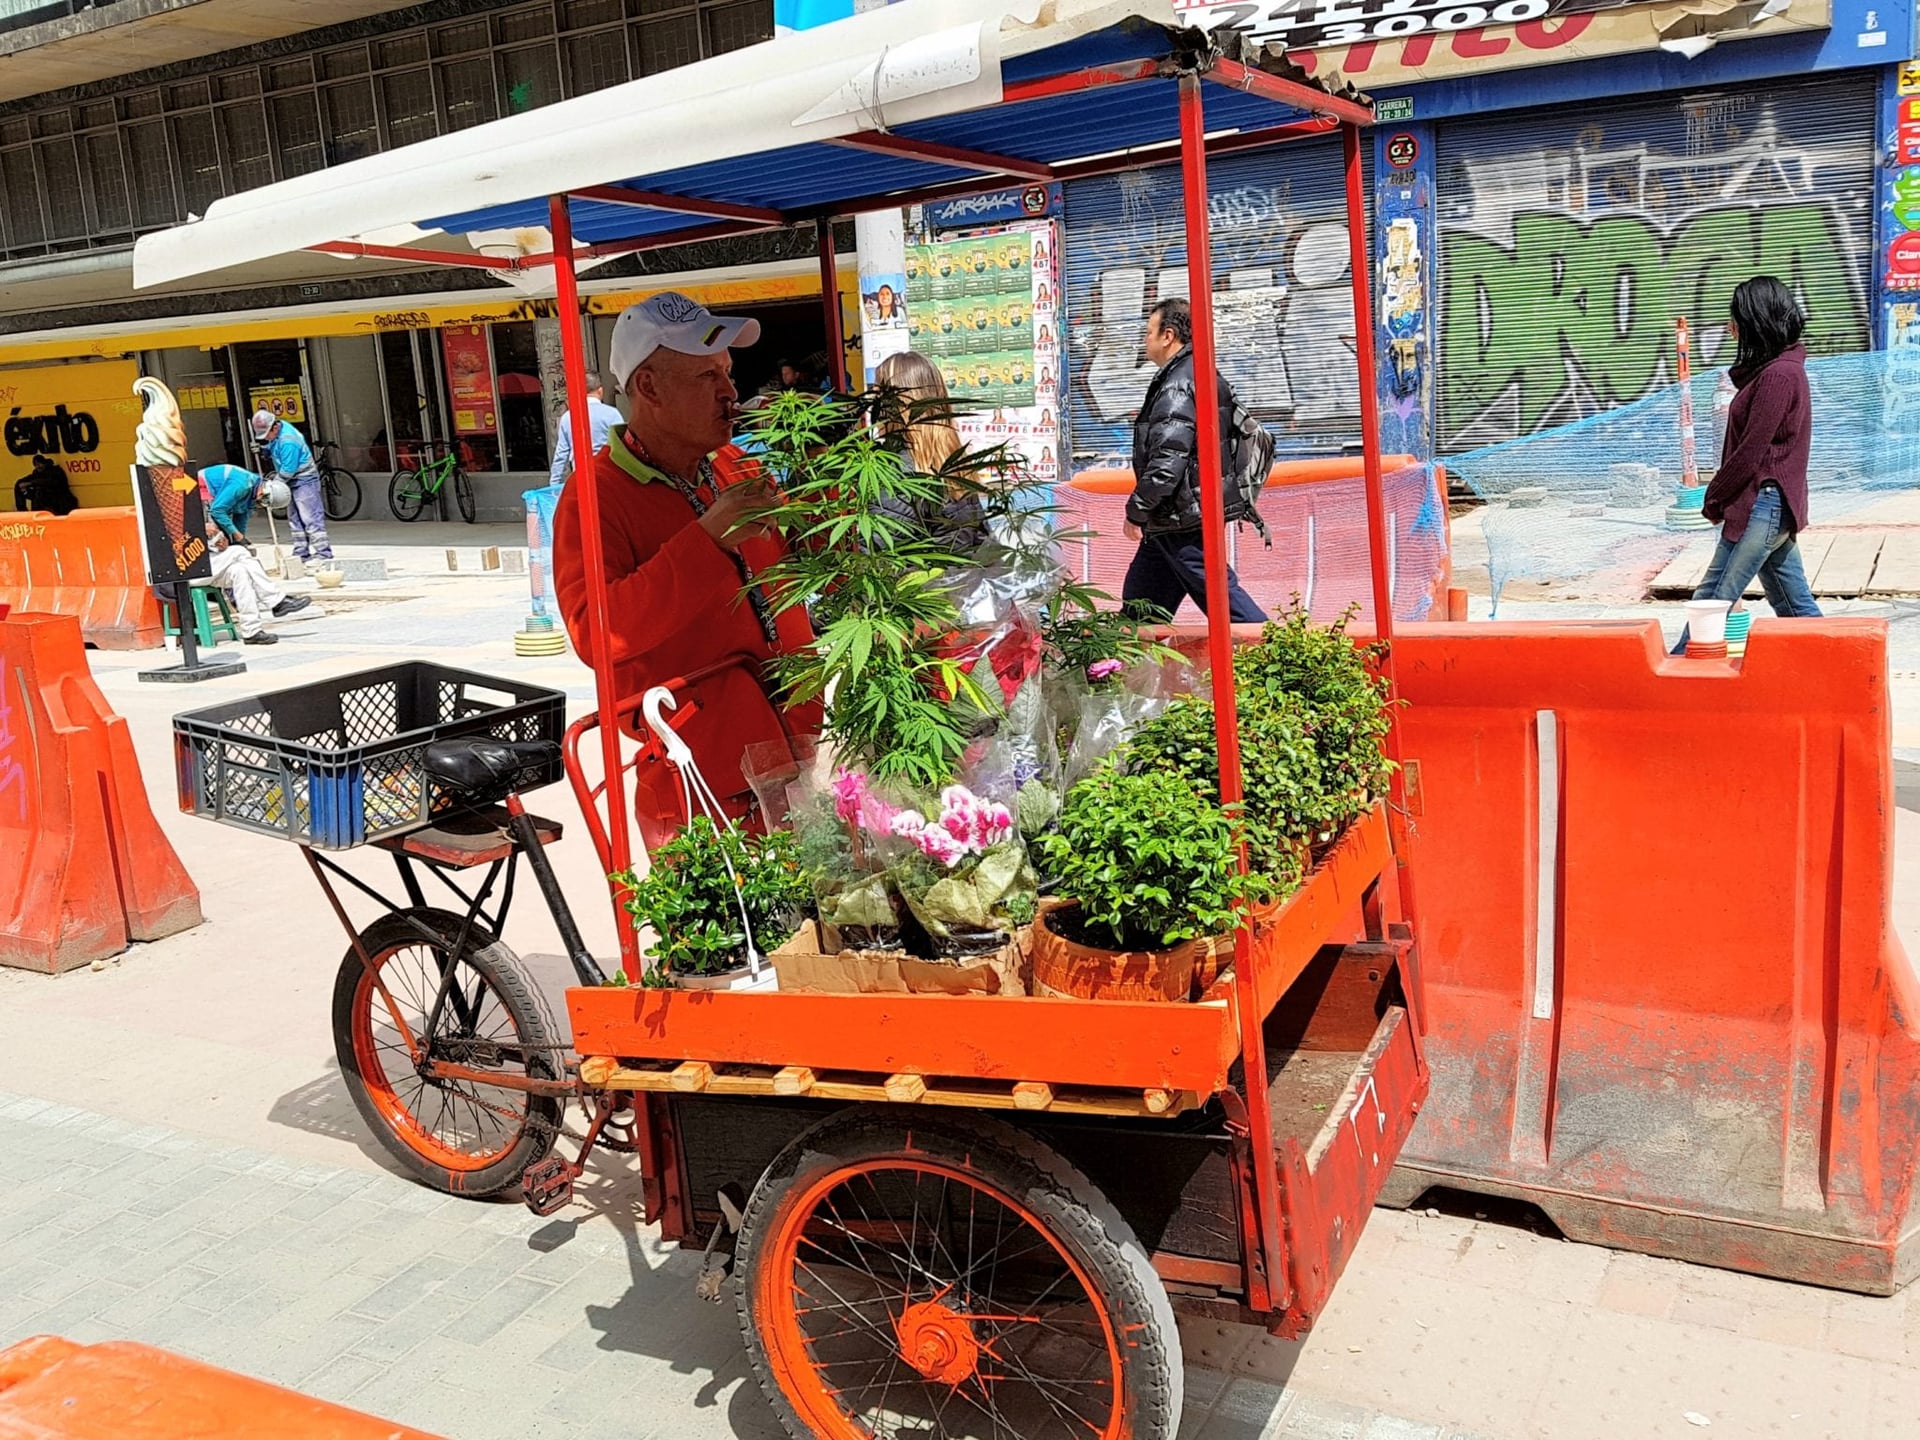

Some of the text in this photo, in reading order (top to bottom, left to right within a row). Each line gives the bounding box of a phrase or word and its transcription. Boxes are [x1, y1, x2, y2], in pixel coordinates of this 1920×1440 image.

[1318, 0, 1549, 46] 3000
[1379, 100, 1407, 111] CARRERA
[66, 458, 101, 473] vecino
[176, 537, 205, 571] $1.000
